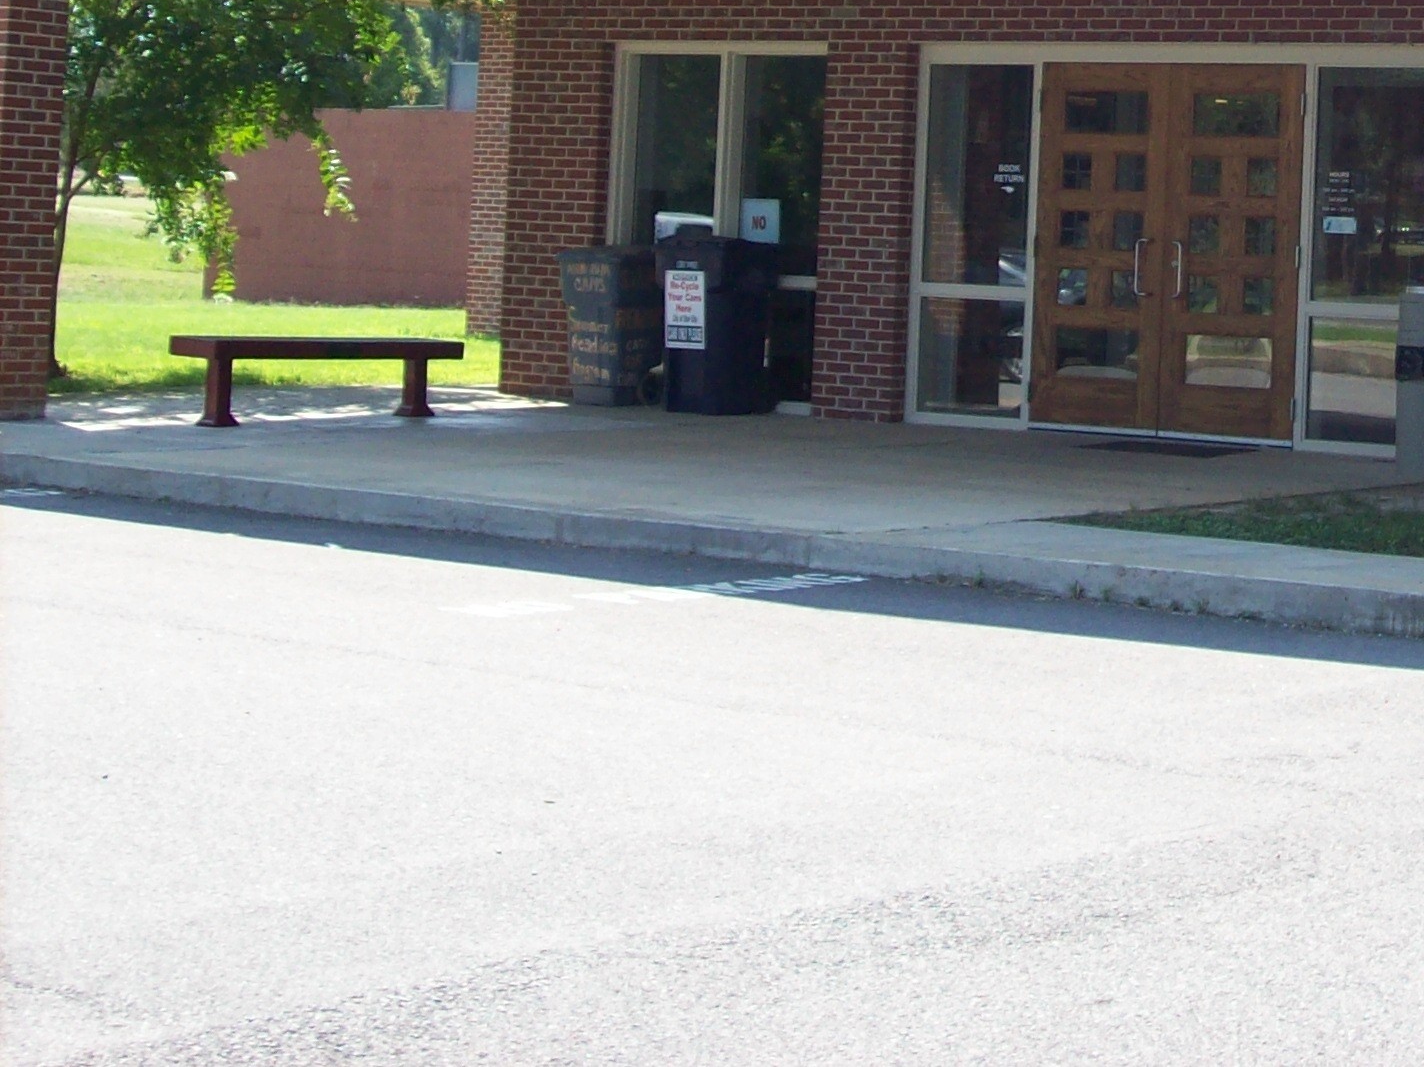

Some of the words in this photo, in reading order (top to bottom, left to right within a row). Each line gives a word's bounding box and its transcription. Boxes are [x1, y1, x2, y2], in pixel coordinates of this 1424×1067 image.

[998, 163, 1020, 173] BOOK
[993, 173, 1024, 183] RETURN
[751, 215, 767, 230] NO
[667, 292, 683, 302] Your
[685, 293, 702, 303] Cans
[675, 304, 692, 313] Here
